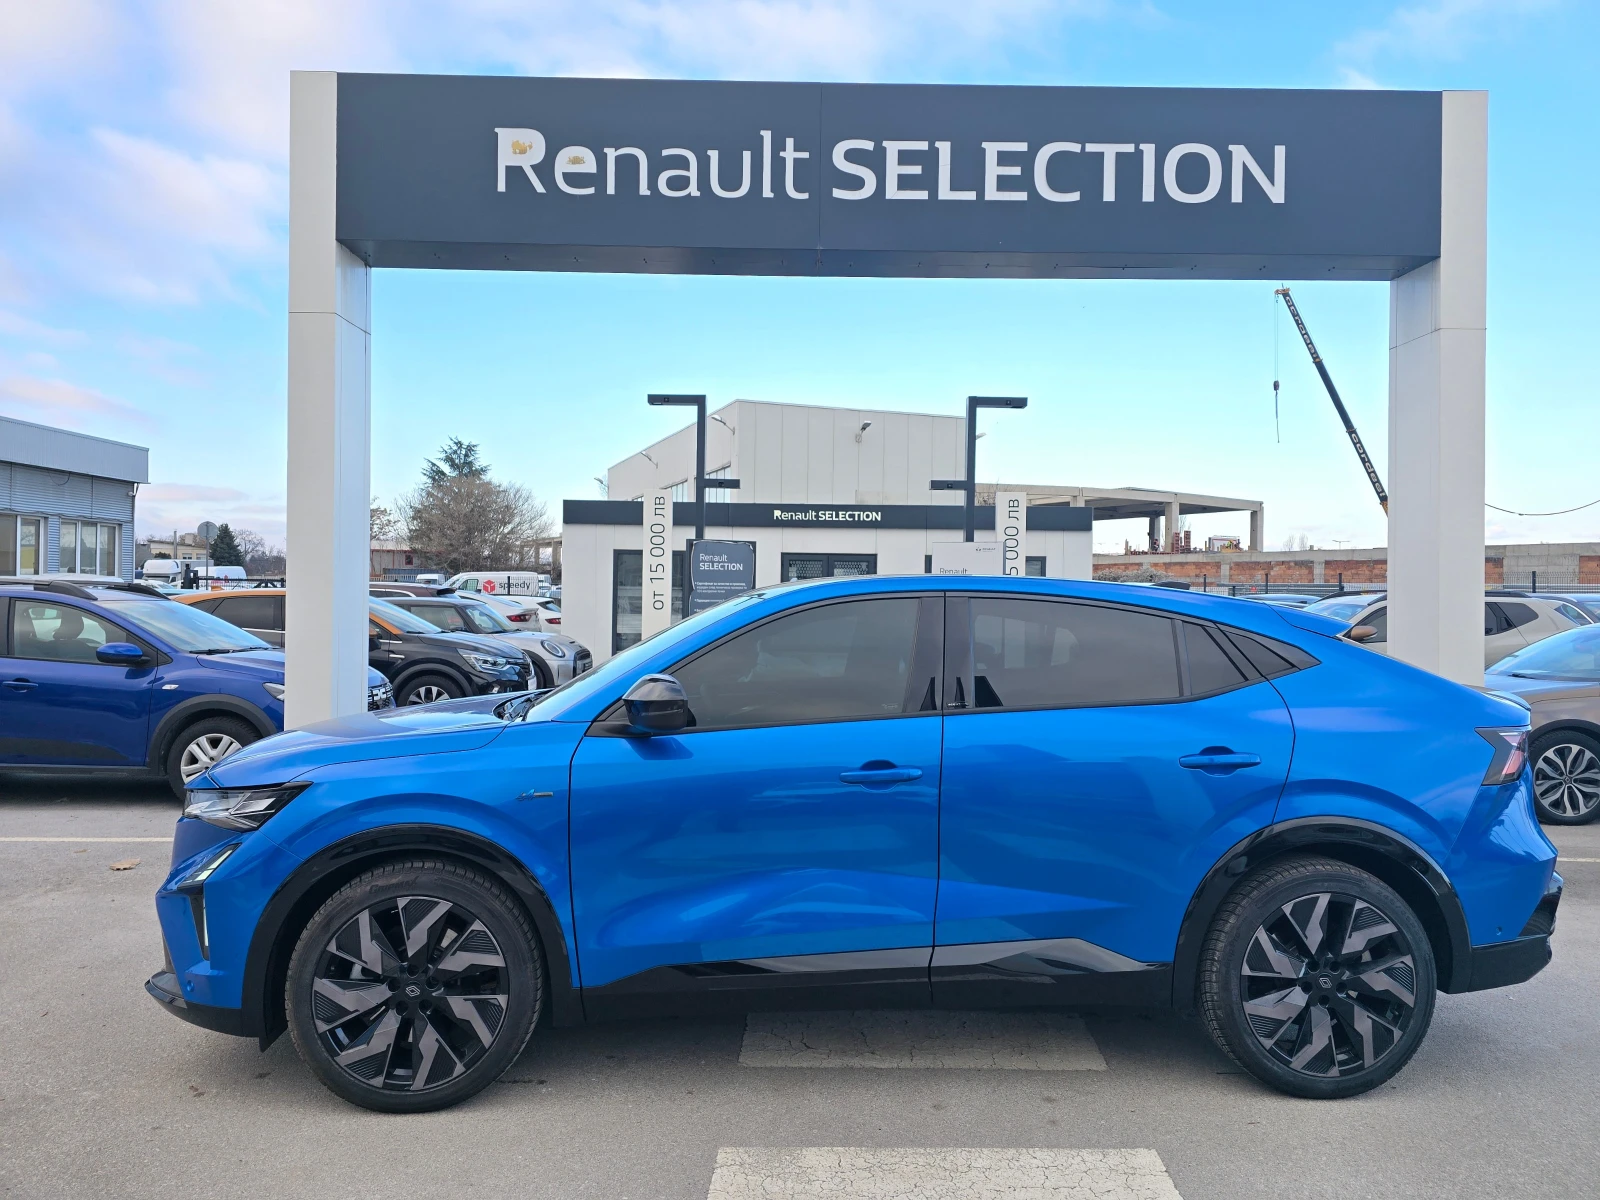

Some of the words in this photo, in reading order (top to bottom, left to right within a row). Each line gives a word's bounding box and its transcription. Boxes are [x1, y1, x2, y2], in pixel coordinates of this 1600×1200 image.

[495, 128, 810, 199] Renault
[831, 138, 1287, 204] SELECTION
[773, 510, 816, 520] Renault
[818, 511, 881, 521] SELECTION
[650, 523, 665, 558] 000
[1004, 526, 1019, 561] 000
[699, 553, 728, 561] Renault
[650, 563, 665, 584] 15
[699, 562, 743, 571] SELECTION
[498, 580, 531, 590] speedy
